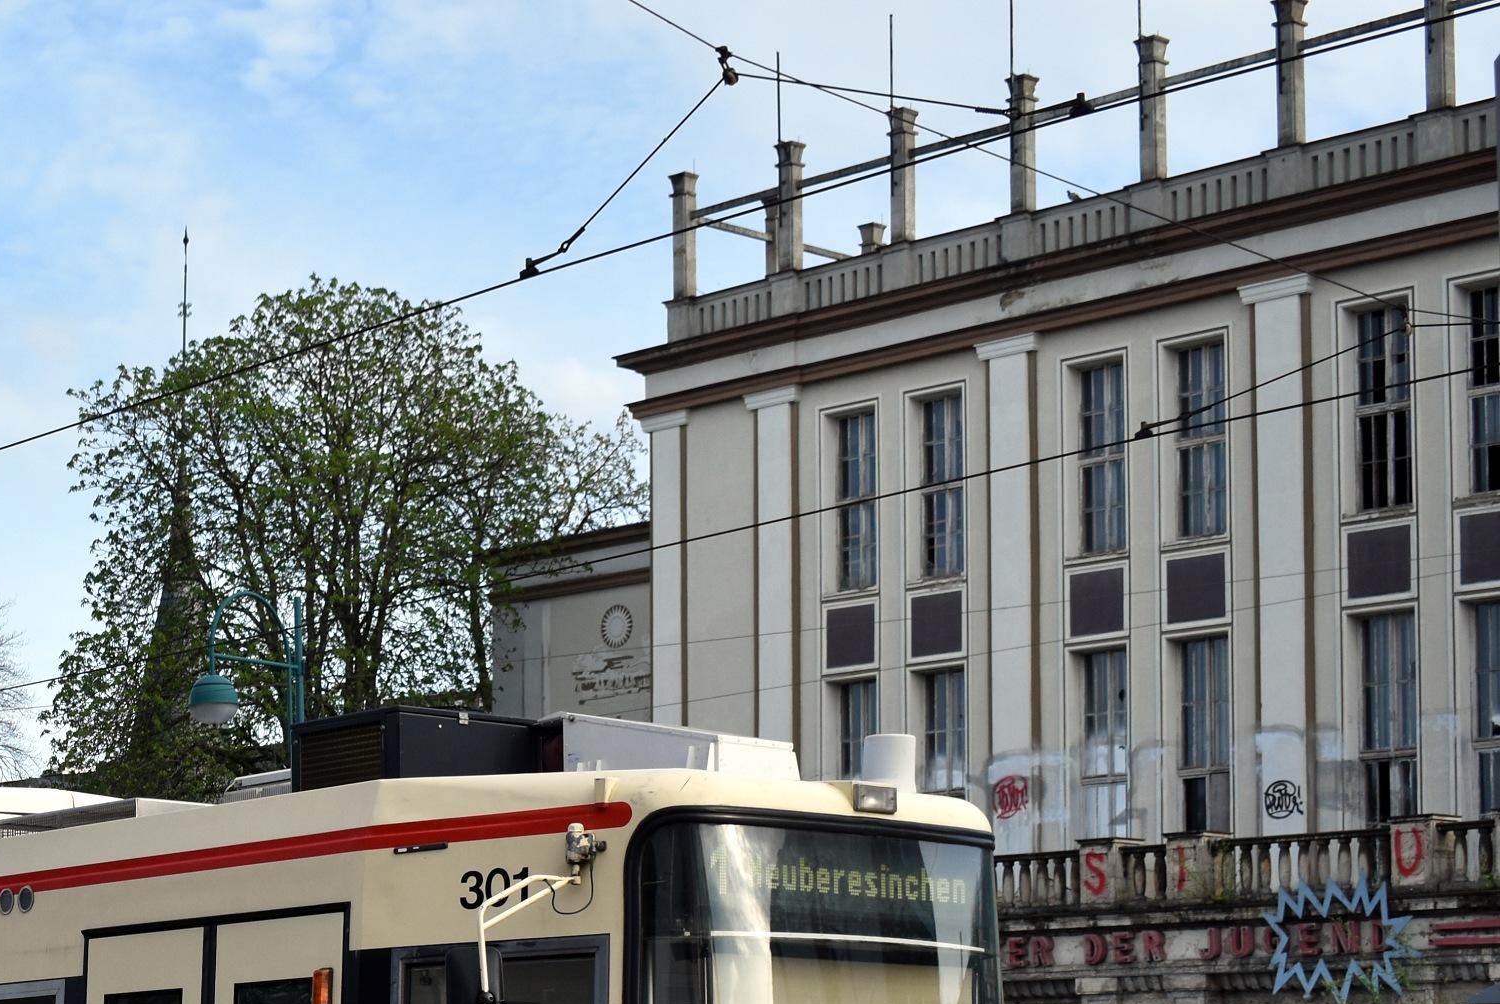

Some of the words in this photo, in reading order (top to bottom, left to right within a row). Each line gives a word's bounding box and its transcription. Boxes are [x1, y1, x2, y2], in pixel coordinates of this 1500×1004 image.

[460, 867, 529, 909] 301
[710, 850, 727, 896] 1
[751, 857, 966, 904] Neuberesinchen
[1084, 930, 1167, 964] DER
